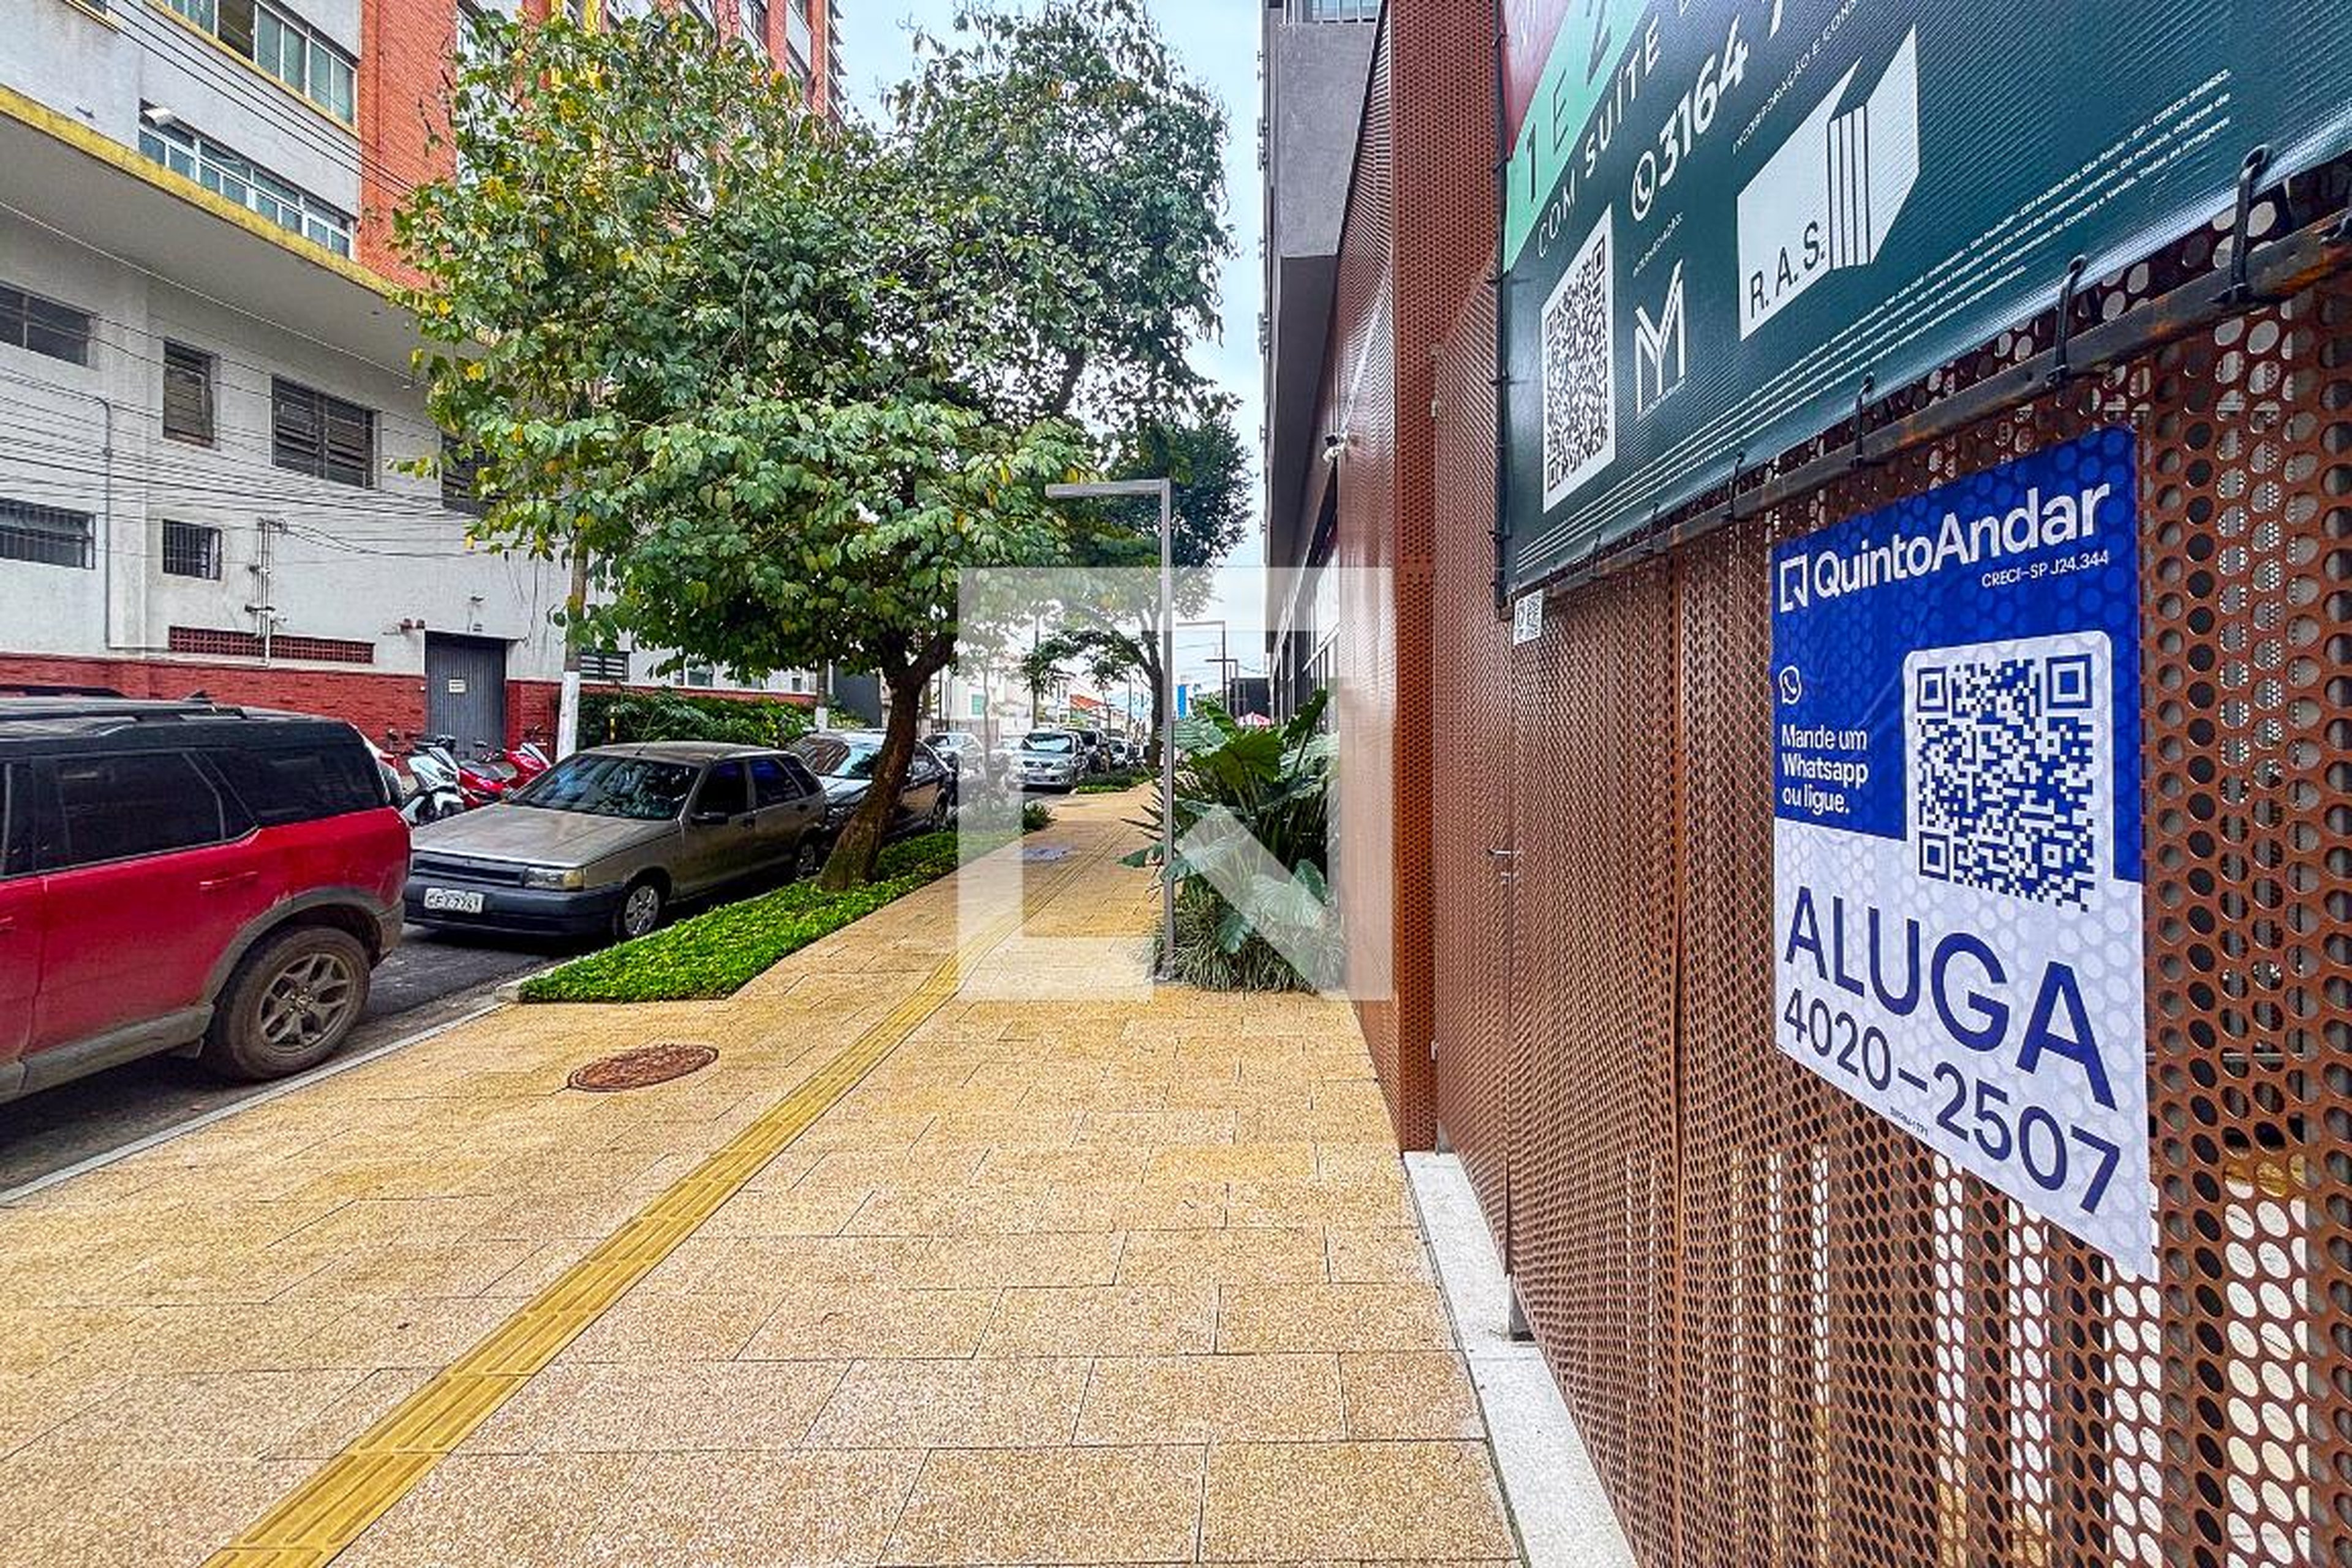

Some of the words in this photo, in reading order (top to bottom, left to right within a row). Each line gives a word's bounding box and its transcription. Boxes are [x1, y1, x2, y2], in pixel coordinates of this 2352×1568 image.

[1538, 168, 1575, 258] COM
[1585, 12, 1660, 179] SUÍTE
[1814, 483, 2111, 599] QuintoAndar
[1981, 562, 2049, 589] CRECI-SP
[2049, 549, 2109, 575] J24.344
[1781, 724, 1836, 750] Mande
[1838, 730, 1868, 750] um
[1781, 753, 1869, 791] Whatsapp
[1782, 786, 1802, 807] ou
[1803, 783, 1850, 816] ligue.
[1784, 886, 2117, 1112] ALUGA
[1784, 988, 2121, 1215] 4020-2507
